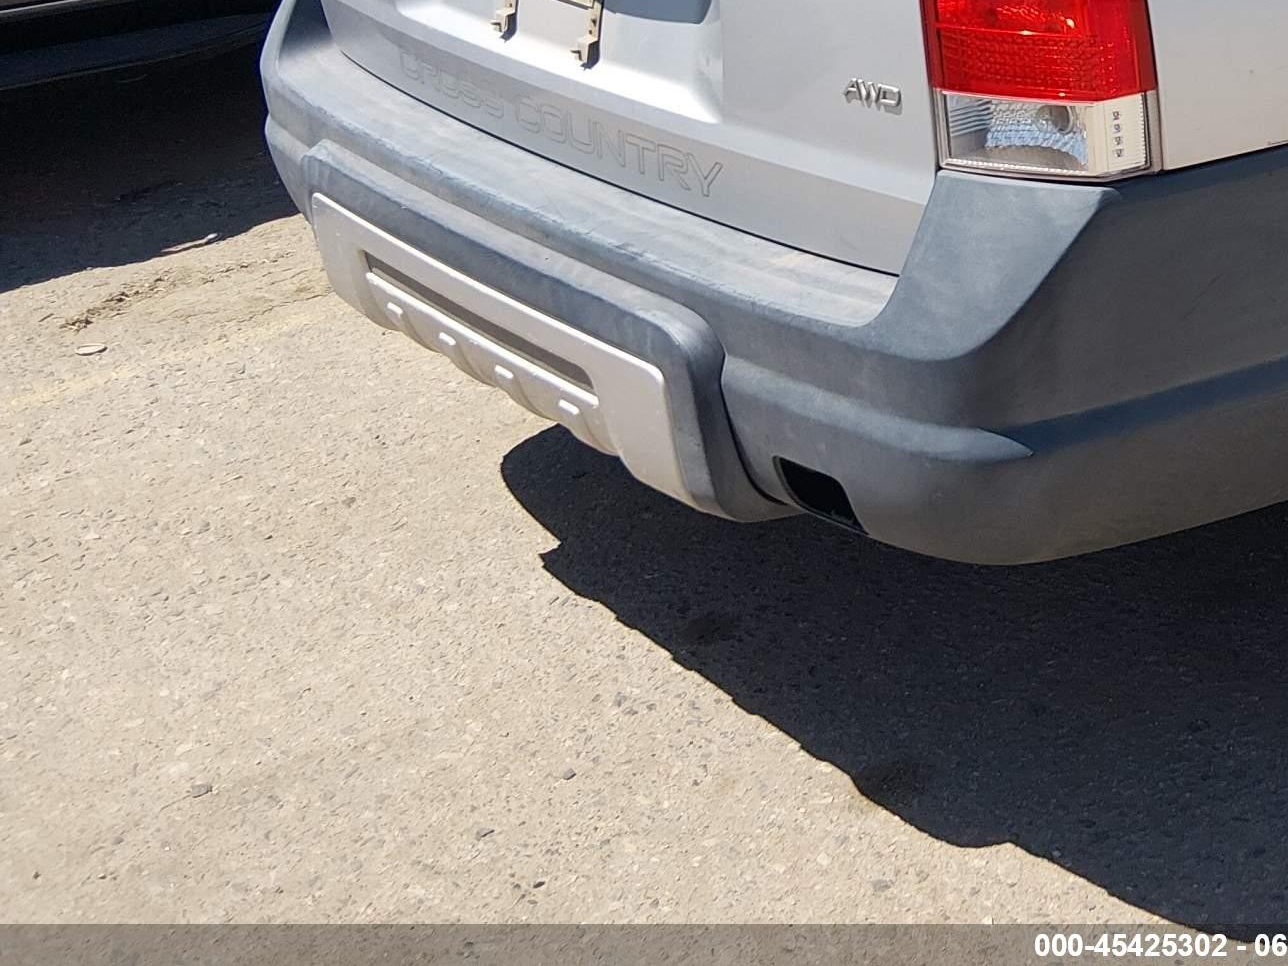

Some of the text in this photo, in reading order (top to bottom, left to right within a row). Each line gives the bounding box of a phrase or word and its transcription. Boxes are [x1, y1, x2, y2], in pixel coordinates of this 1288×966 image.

[401, 50, 724, 198] CROSS COUNTRY
[844, 78, 902, 109] AWD
